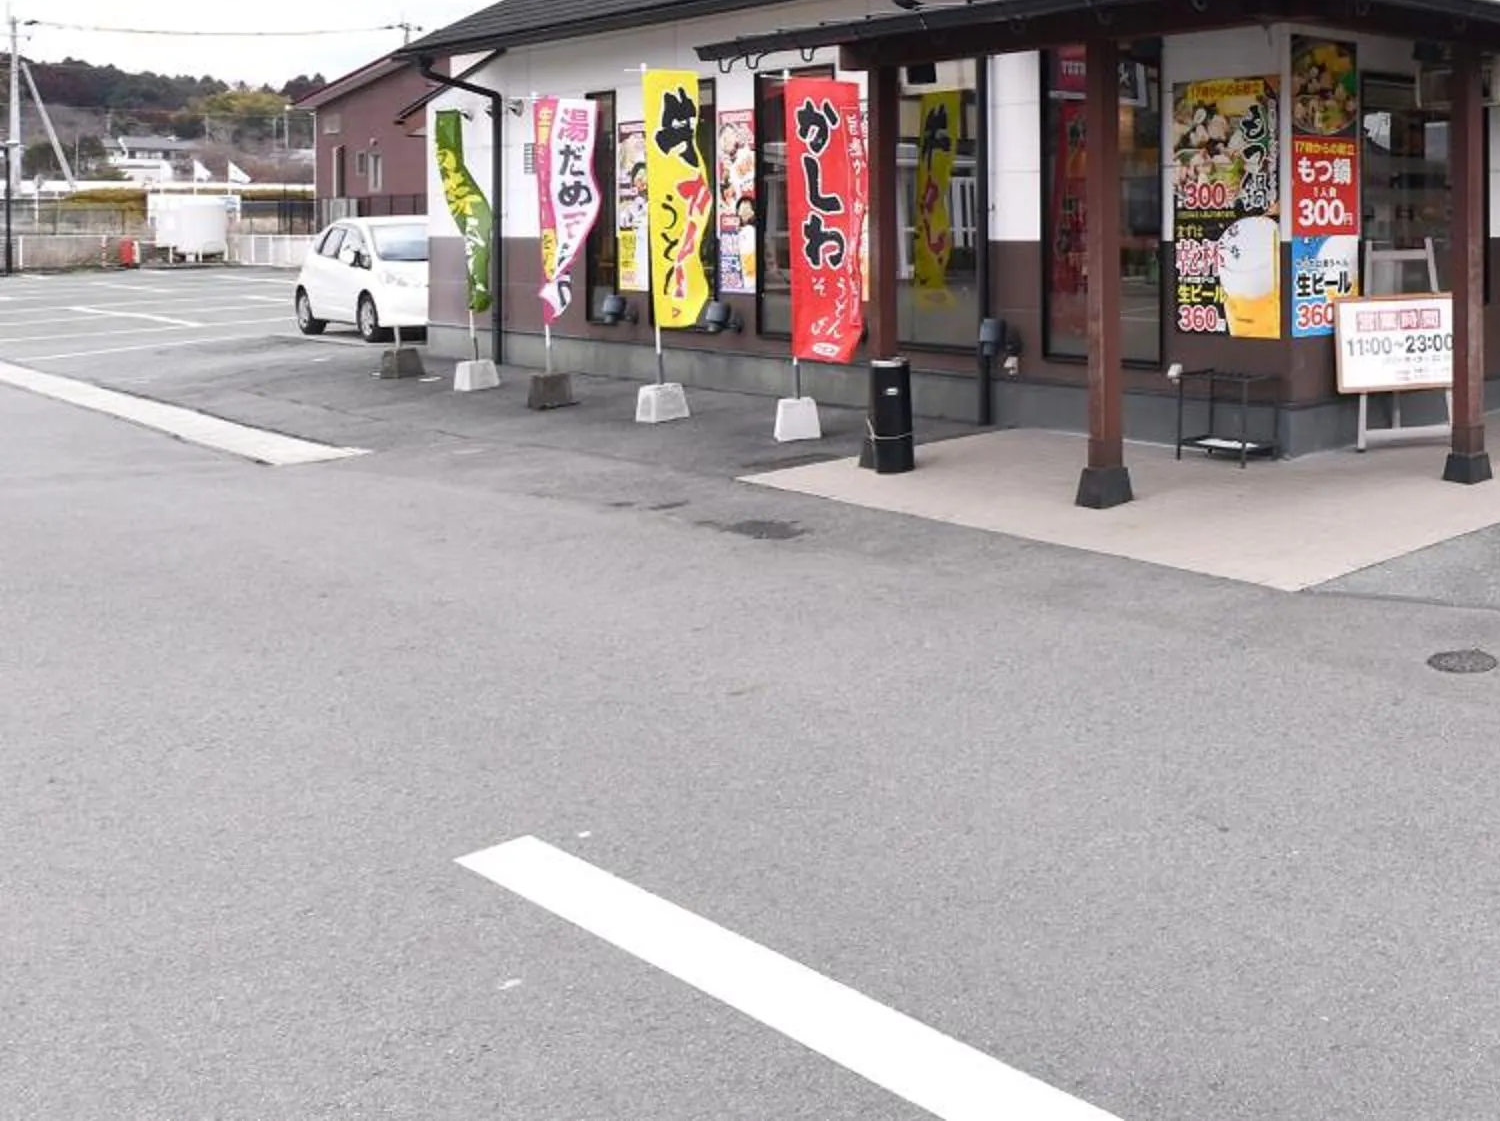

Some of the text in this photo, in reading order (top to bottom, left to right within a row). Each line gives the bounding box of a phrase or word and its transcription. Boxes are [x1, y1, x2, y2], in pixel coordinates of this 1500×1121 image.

[797, 98, 843, 268] かしわ
[1297, 156, 1352, 185] もつ鍋
[1177, 285, 1228, 303] 生ビール
[1296, 270, 1352, 297] 生ビール
